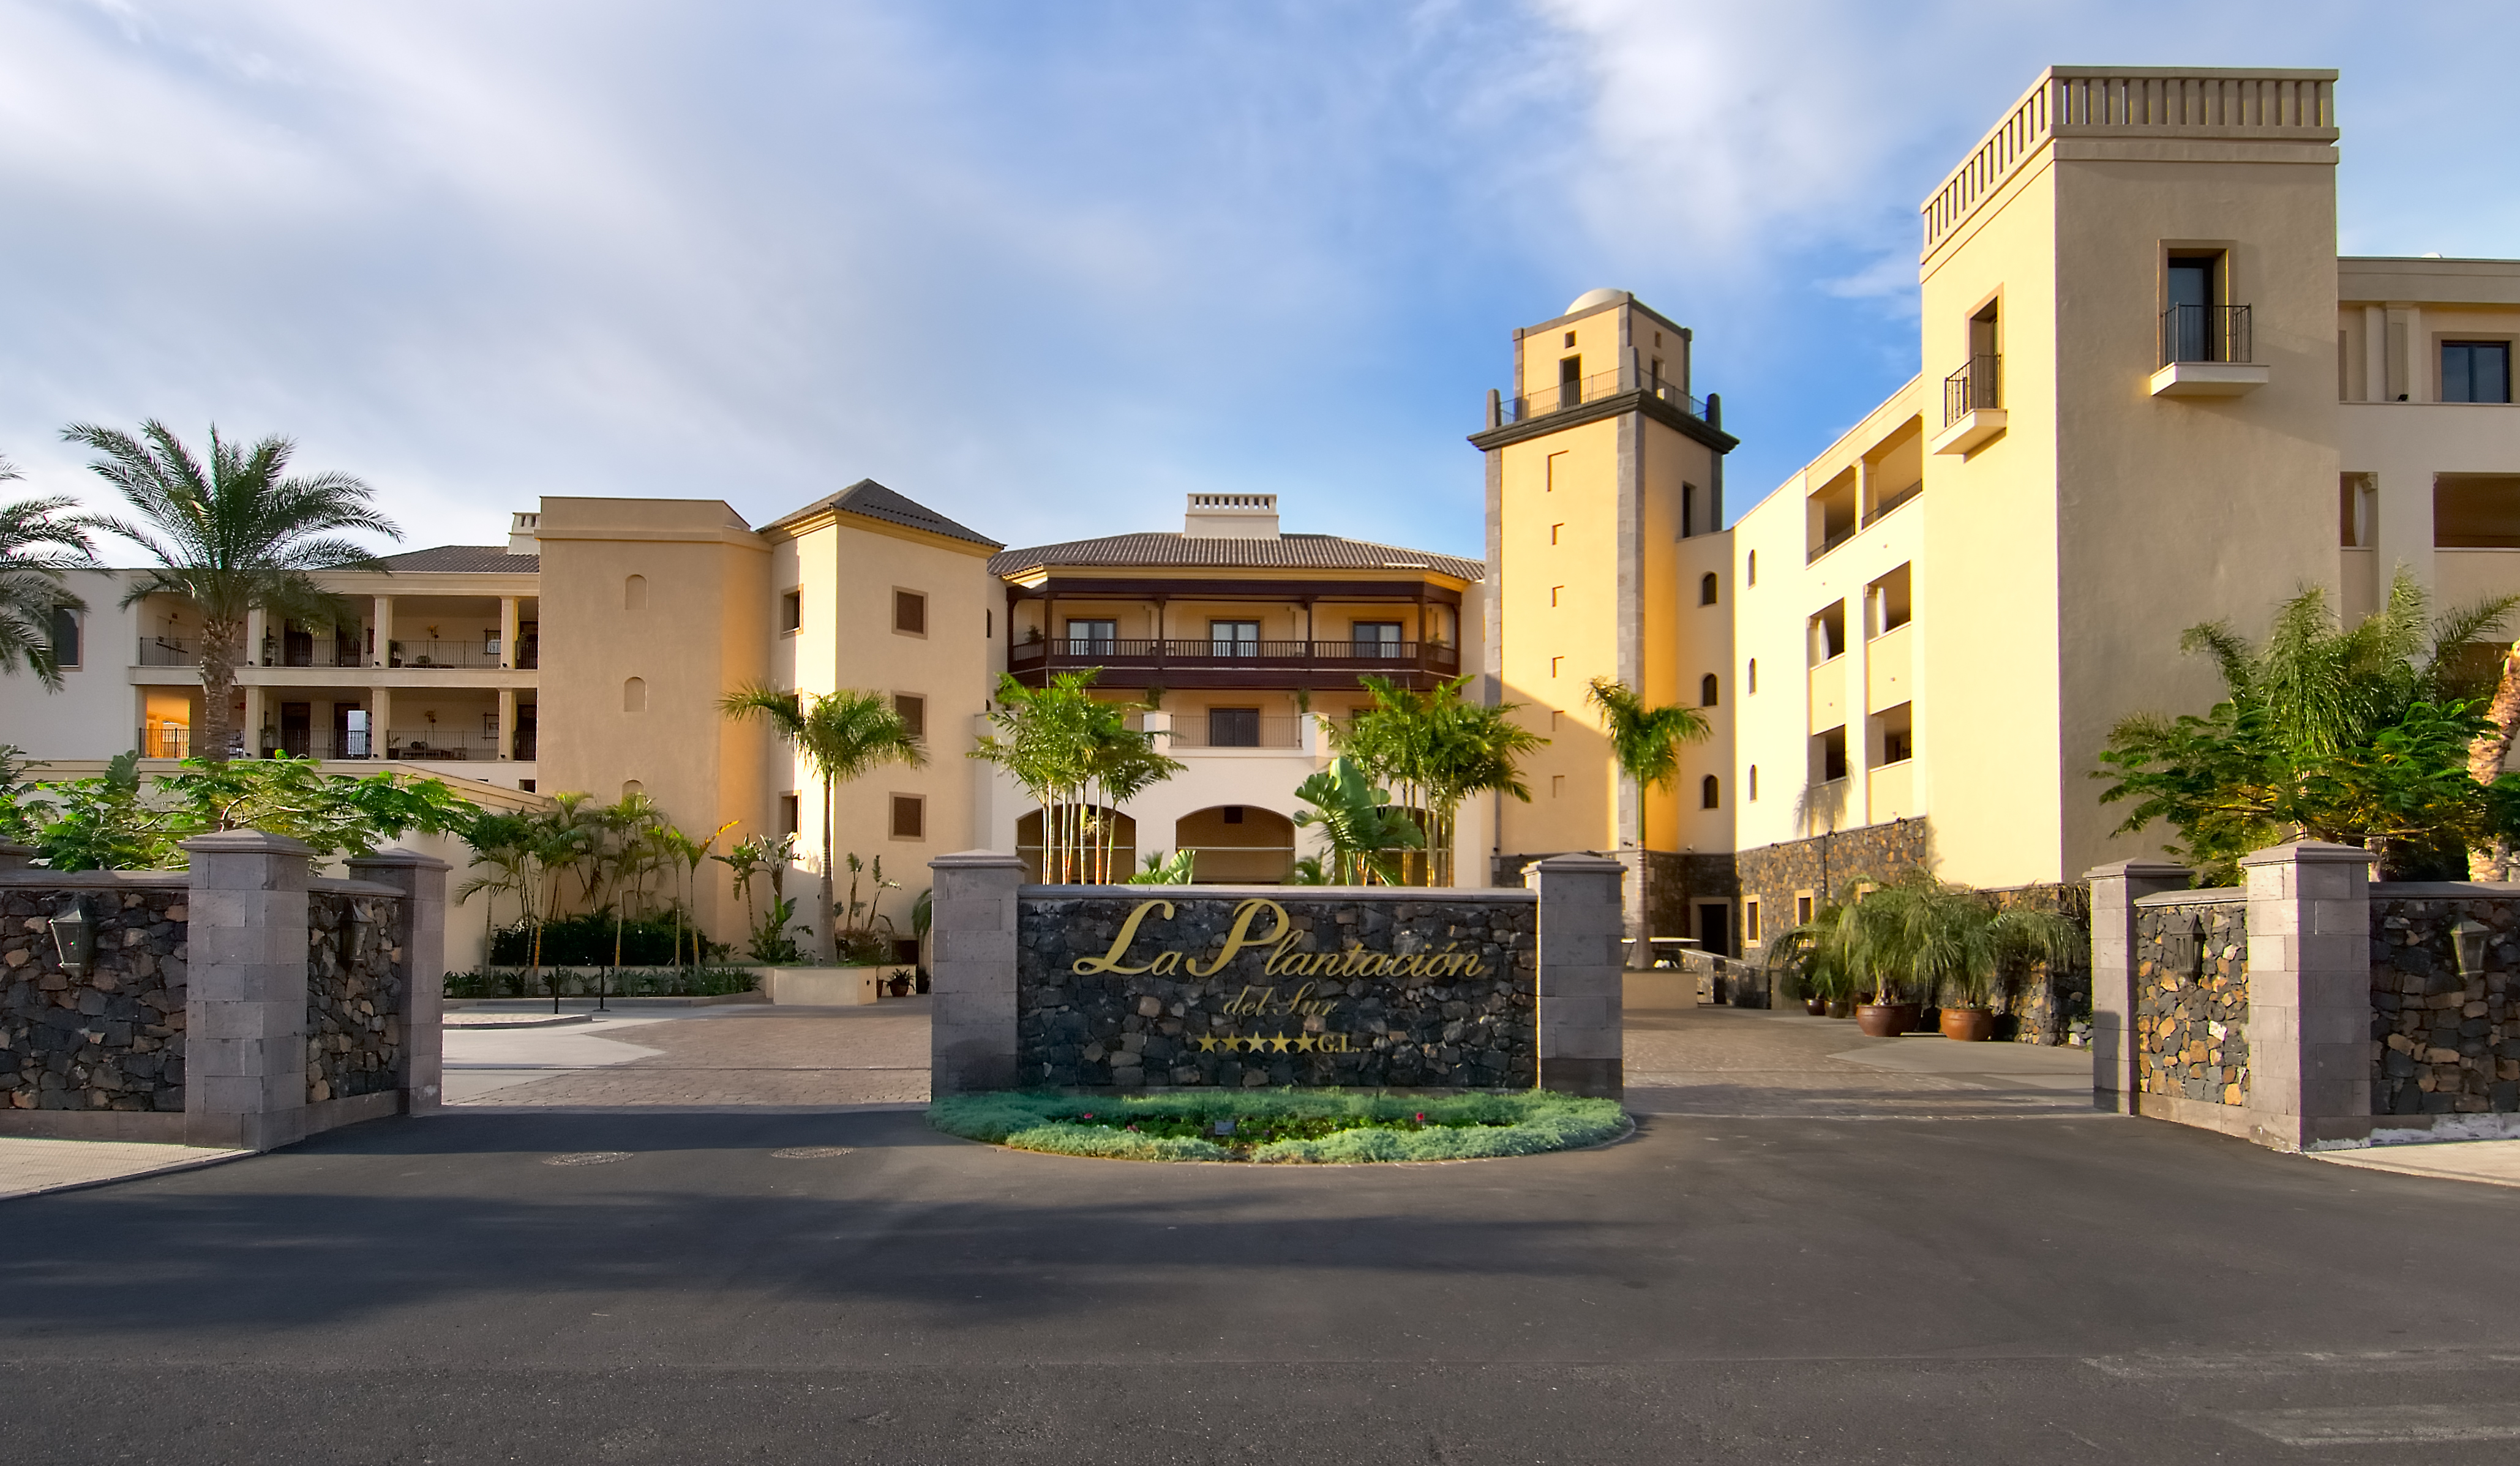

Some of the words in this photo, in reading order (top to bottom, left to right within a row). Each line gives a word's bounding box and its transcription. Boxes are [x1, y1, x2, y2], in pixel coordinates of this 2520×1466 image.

[1073, 900, 1183, 976] La
[1186, 898, 1485, 978] Plantación
[1223, 985, 1274, 1017] del
[1273, 982, 1338, 1017] Sur
[1318, 1034, 1360, 1053] G.L.
